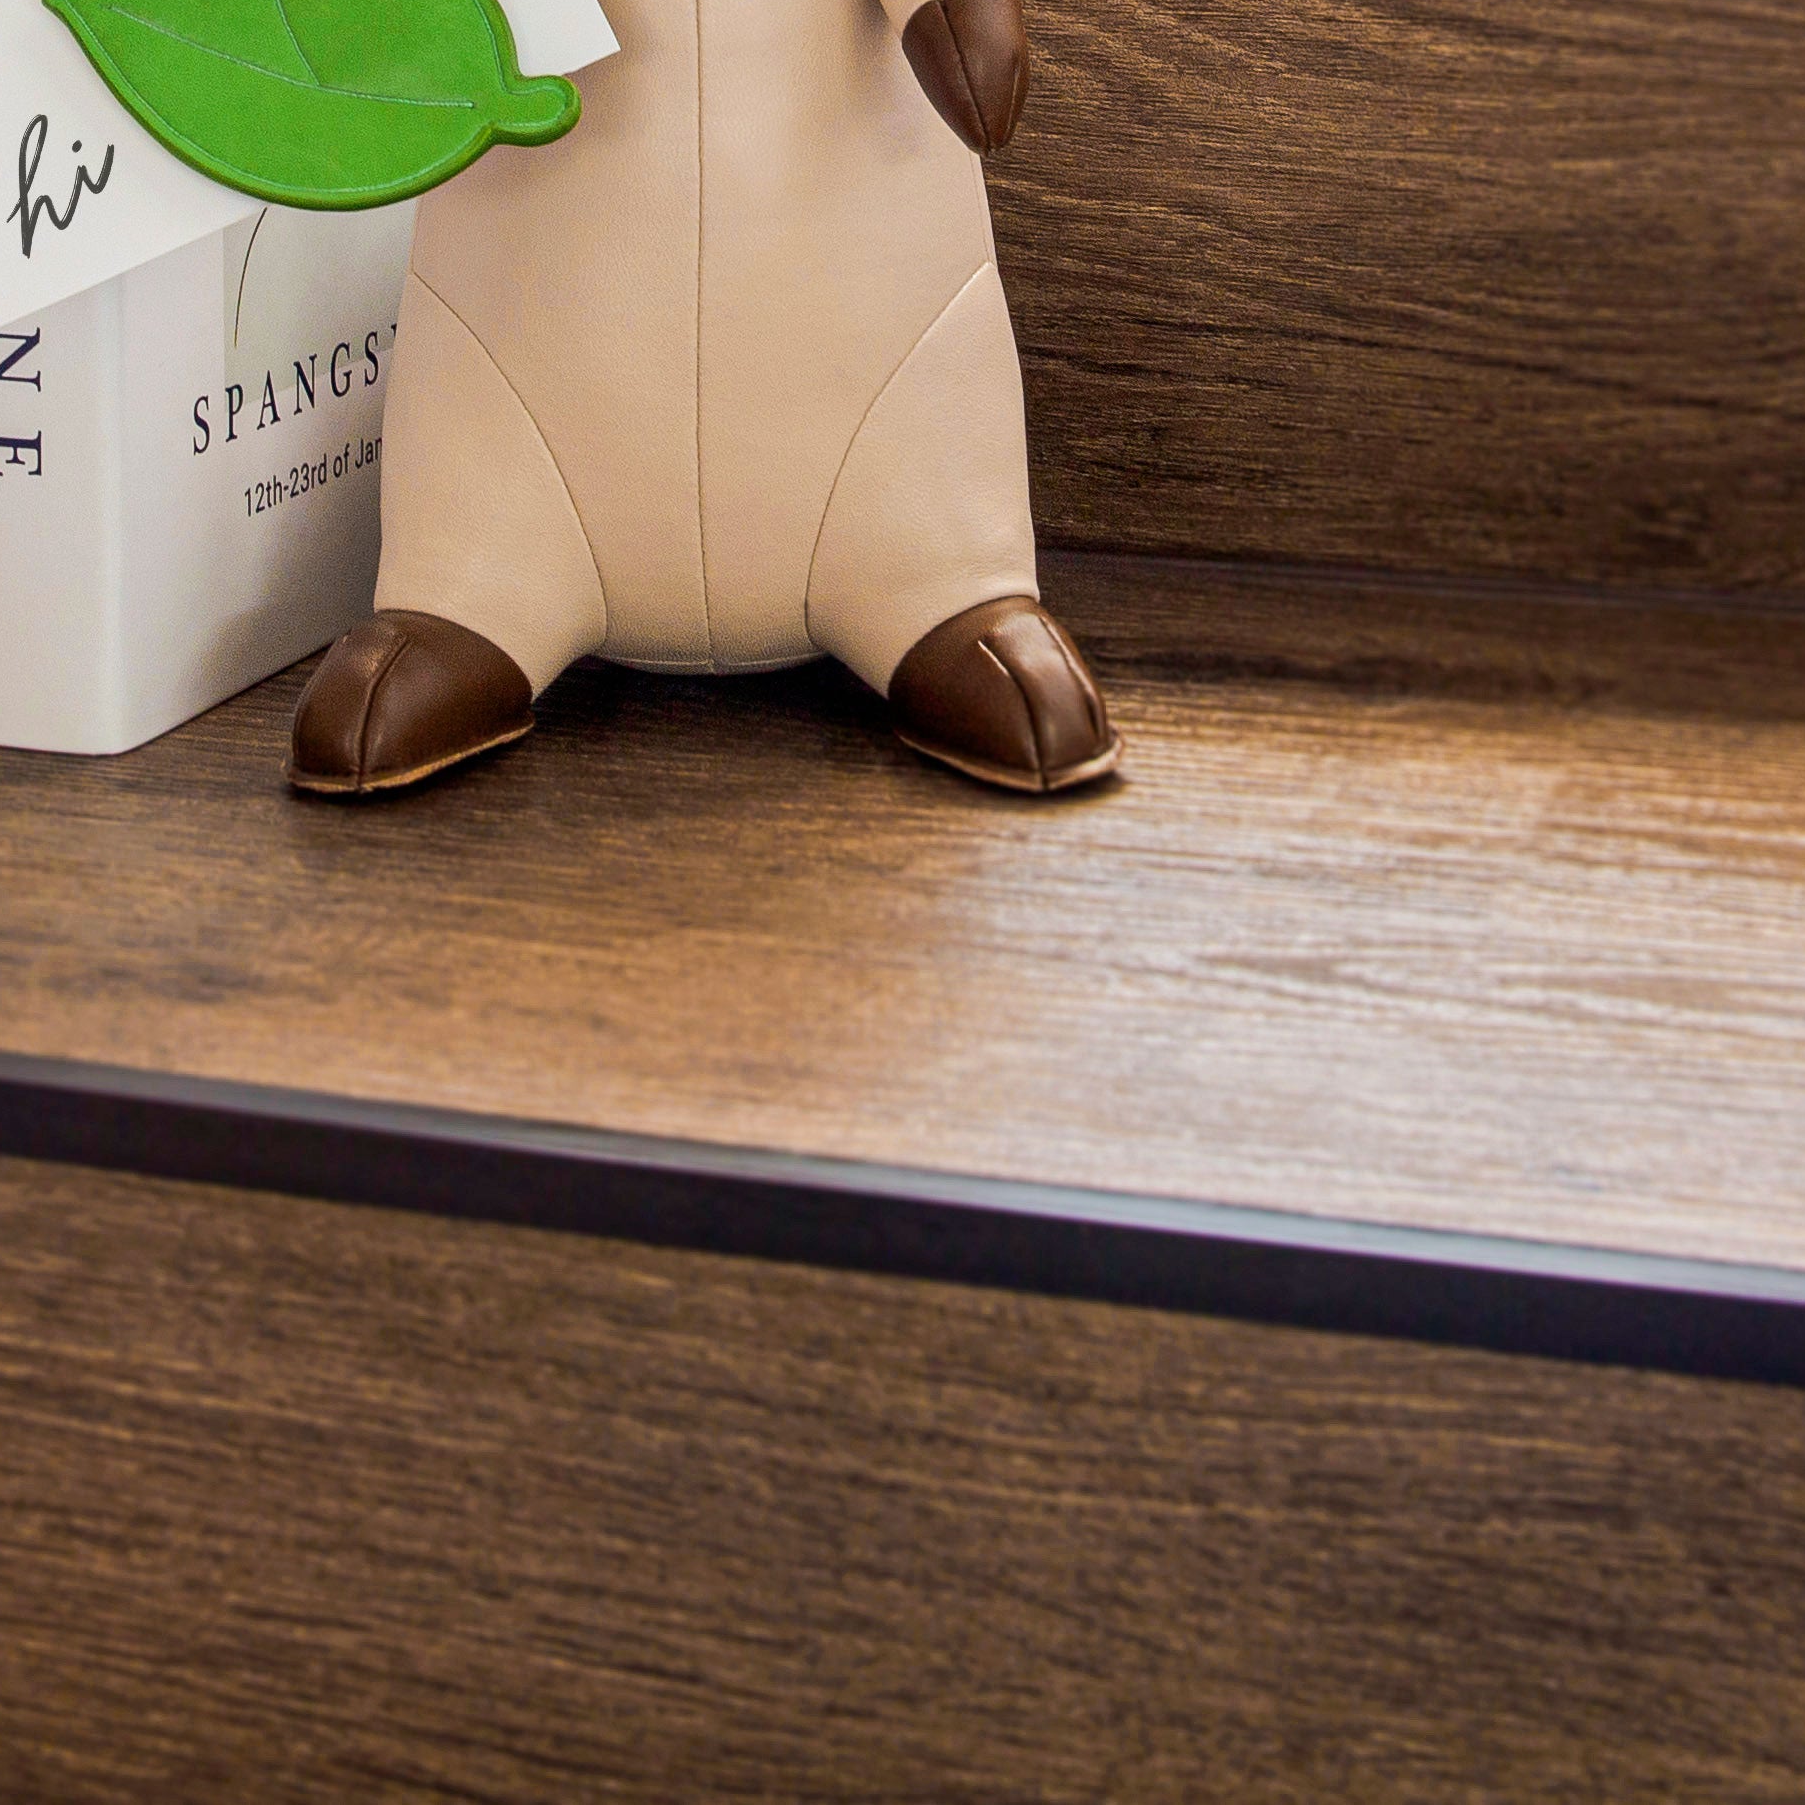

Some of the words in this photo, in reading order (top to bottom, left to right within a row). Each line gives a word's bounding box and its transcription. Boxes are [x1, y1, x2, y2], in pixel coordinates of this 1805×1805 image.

[6, 112, 115, 260] hi
[193, 323, 397, 457] SPANGS
[244, 452, 328, 518] 12th-23rd
[332, 441, 351, 480] of
